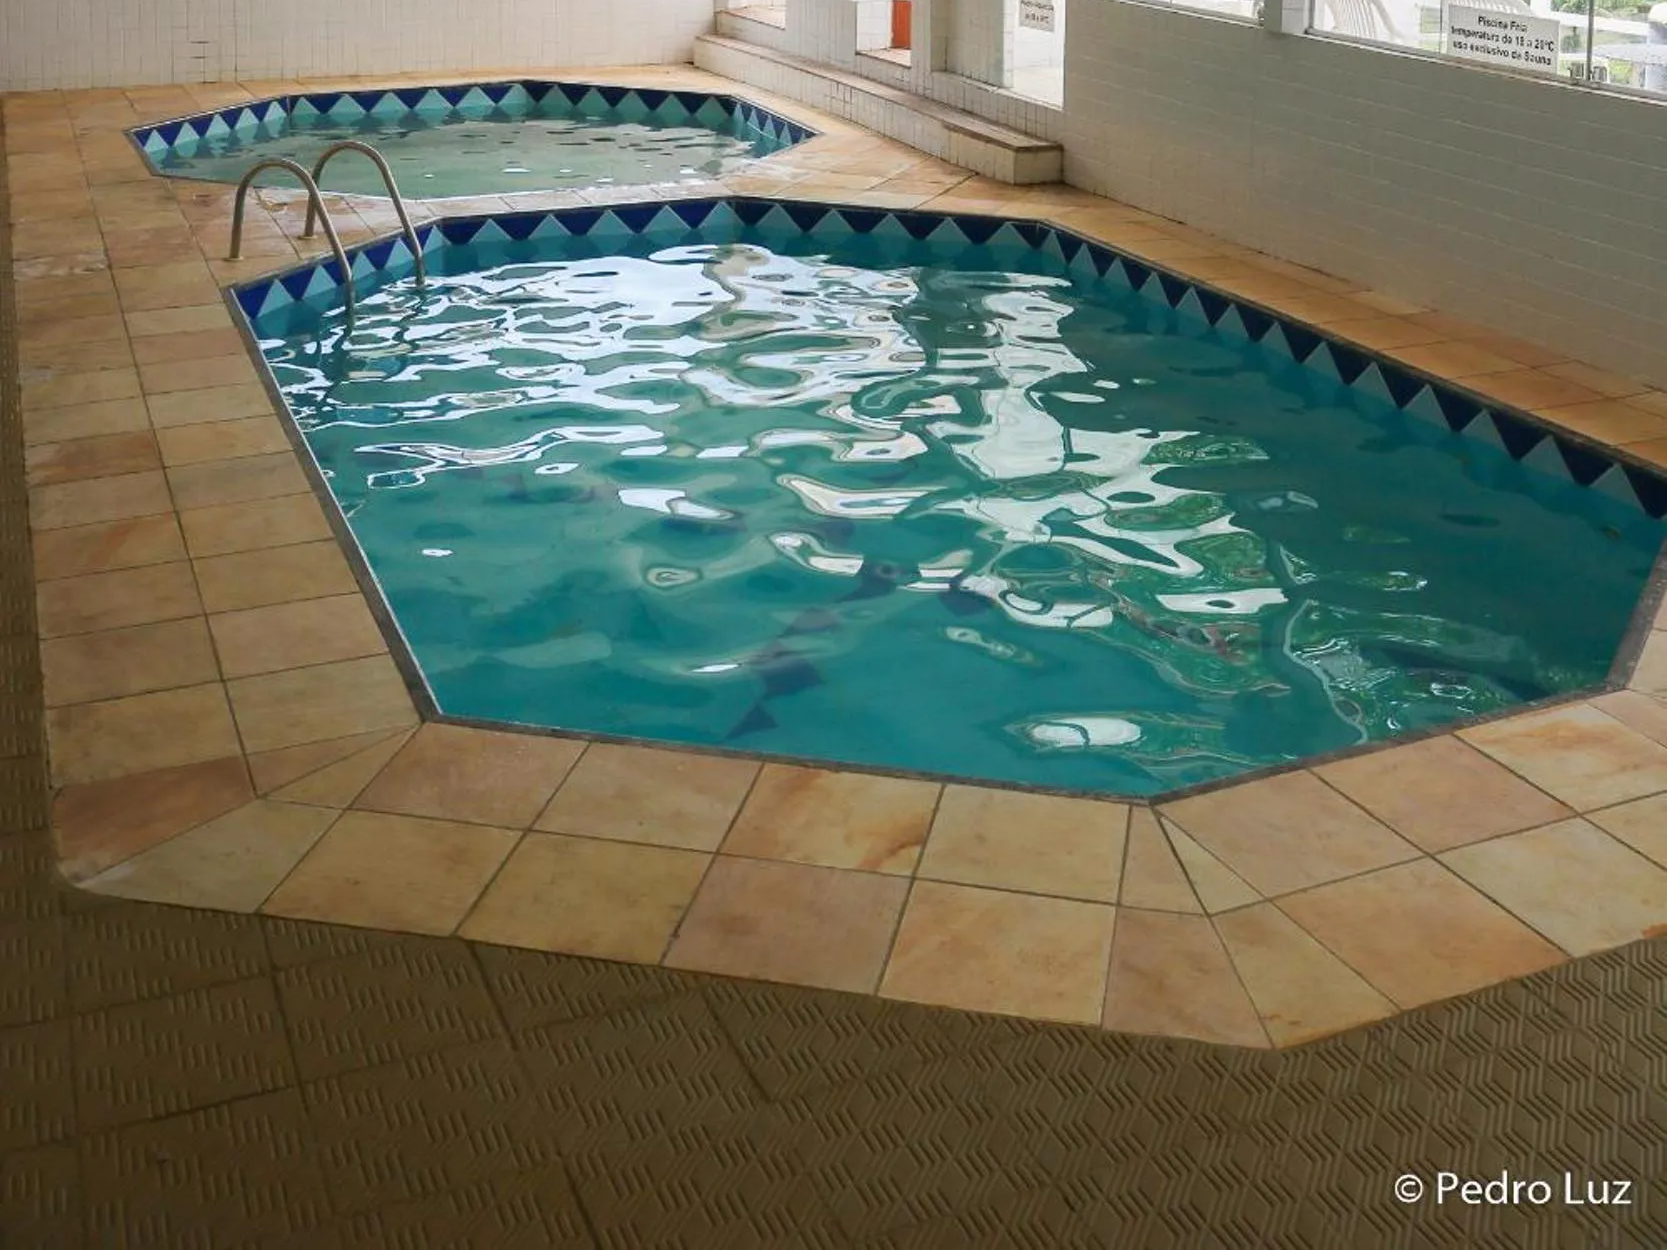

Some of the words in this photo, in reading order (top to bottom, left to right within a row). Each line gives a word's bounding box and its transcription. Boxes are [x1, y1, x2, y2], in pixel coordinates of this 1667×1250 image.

[1478, 16, 1508, 30] Piscina
[1509, 20, 1528, 32] Fria
[1469, 43, 1509, 57] exclusivo
[1523, 51, 1552, 66] Sauna
